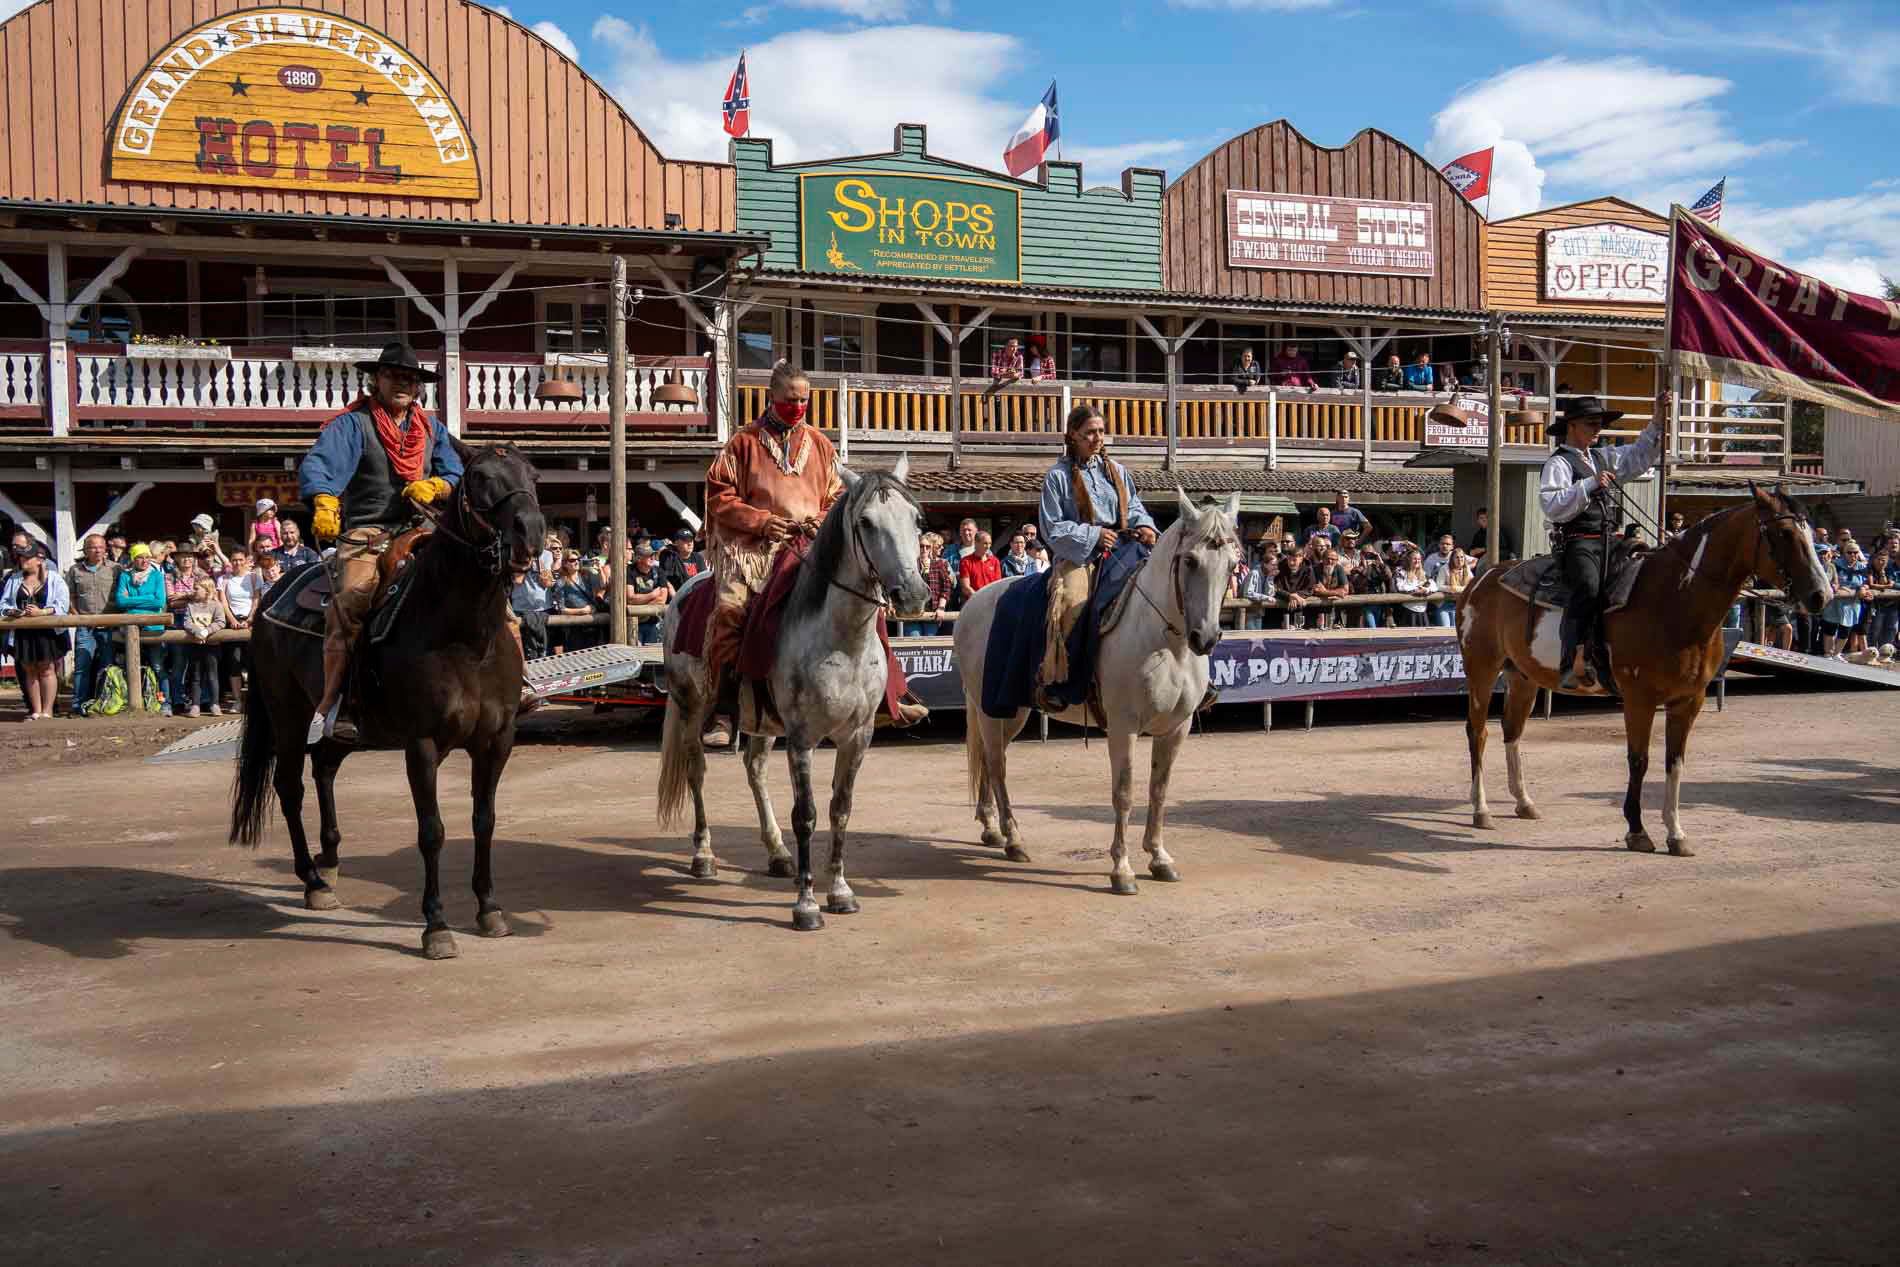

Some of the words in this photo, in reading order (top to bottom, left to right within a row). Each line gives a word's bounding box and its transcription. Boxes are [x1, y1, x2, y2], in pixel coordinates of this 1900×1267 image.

[122, 38, 213, 151] GRAND
[226, 16, 381, 63] SILVER
[391, 62, 466, 160] STAR
[284, 70, 316, 87] 1880
[195, 116, 402, 184] HOTEL
[826, 179, 995, 235] SHOPS
[1236, 198, 1338, 242] GENERAL
[1356, 206, 1426, 247] STORE
[879, 228, 905, 245] IN
[914, 229, 996, 251] TOWN
[1232, 239, 1242, 258] IF
[1243, 240, 1260, 259] WE
[1290, 243, 1316, 263] HAVE
[1347, 247, 1366, 265] YOU
[1396, 249, 1419, 267] NEED
[876, 260, 931, 270] APPRECIATED
[1554, 262, 1661, 295] OFFICE
[1685, 238, 1849, 321] GREAT
[912, 649, 953, 673] HARZ
[1247, 655, 1361, 685] POWER
[1369, 653, 1467, 682] WEEKE
